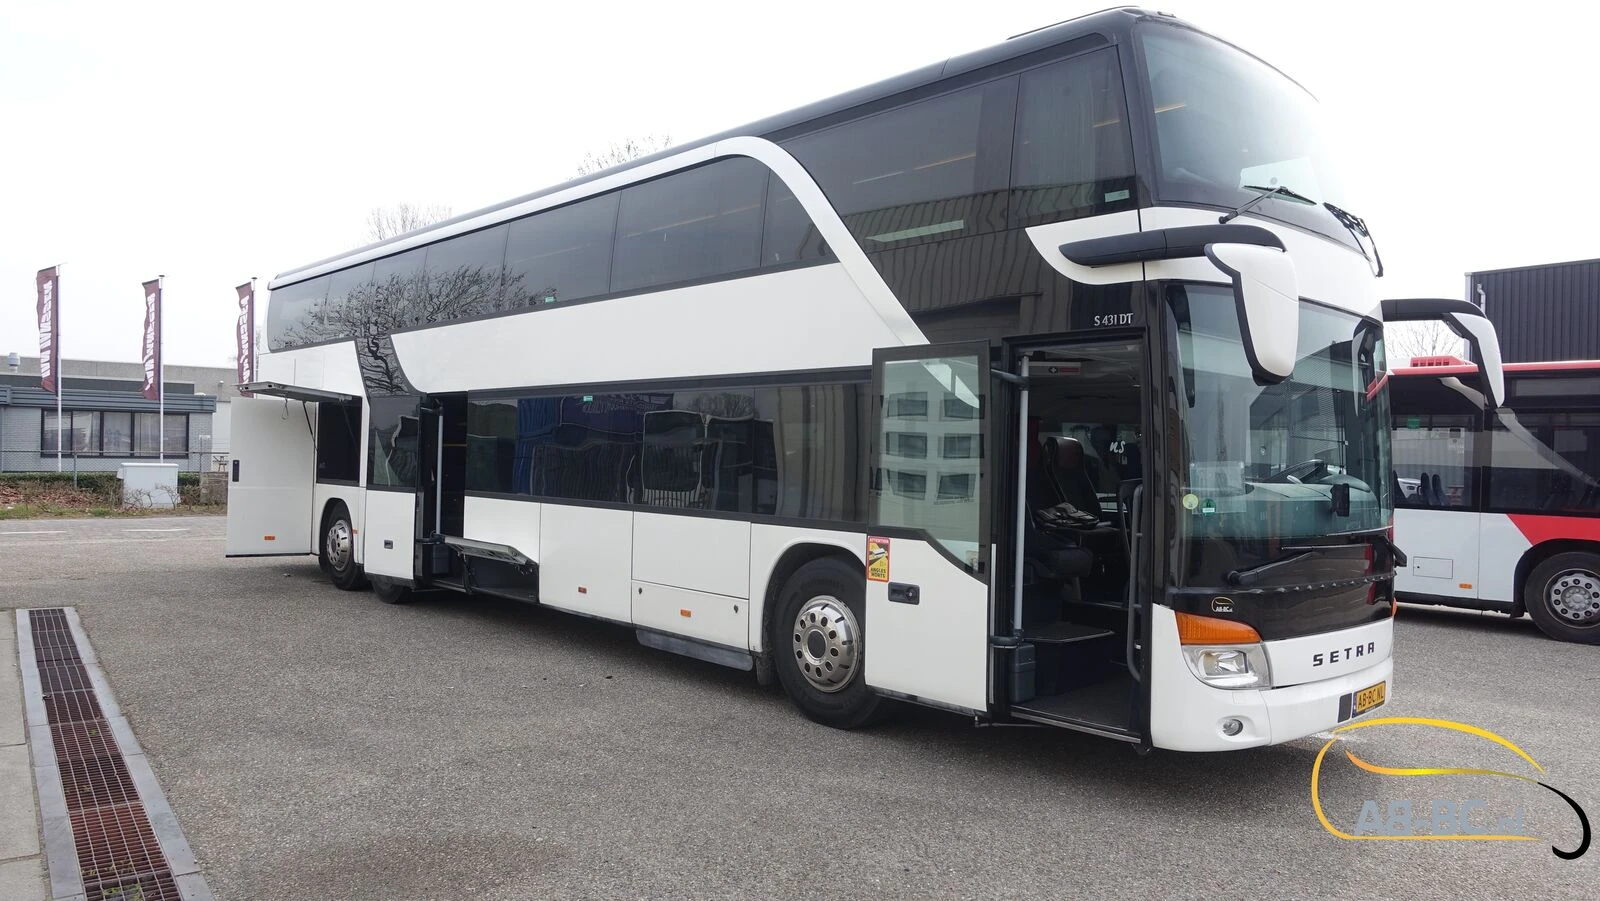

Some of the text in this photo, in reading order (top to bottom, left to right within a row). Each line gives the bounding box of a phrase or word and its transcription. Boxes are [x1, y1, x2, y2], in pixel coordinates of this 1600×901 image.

[1093, 312, 1134, 327] S 431 DT
[1312, 641, 1375, 667] SETRA
